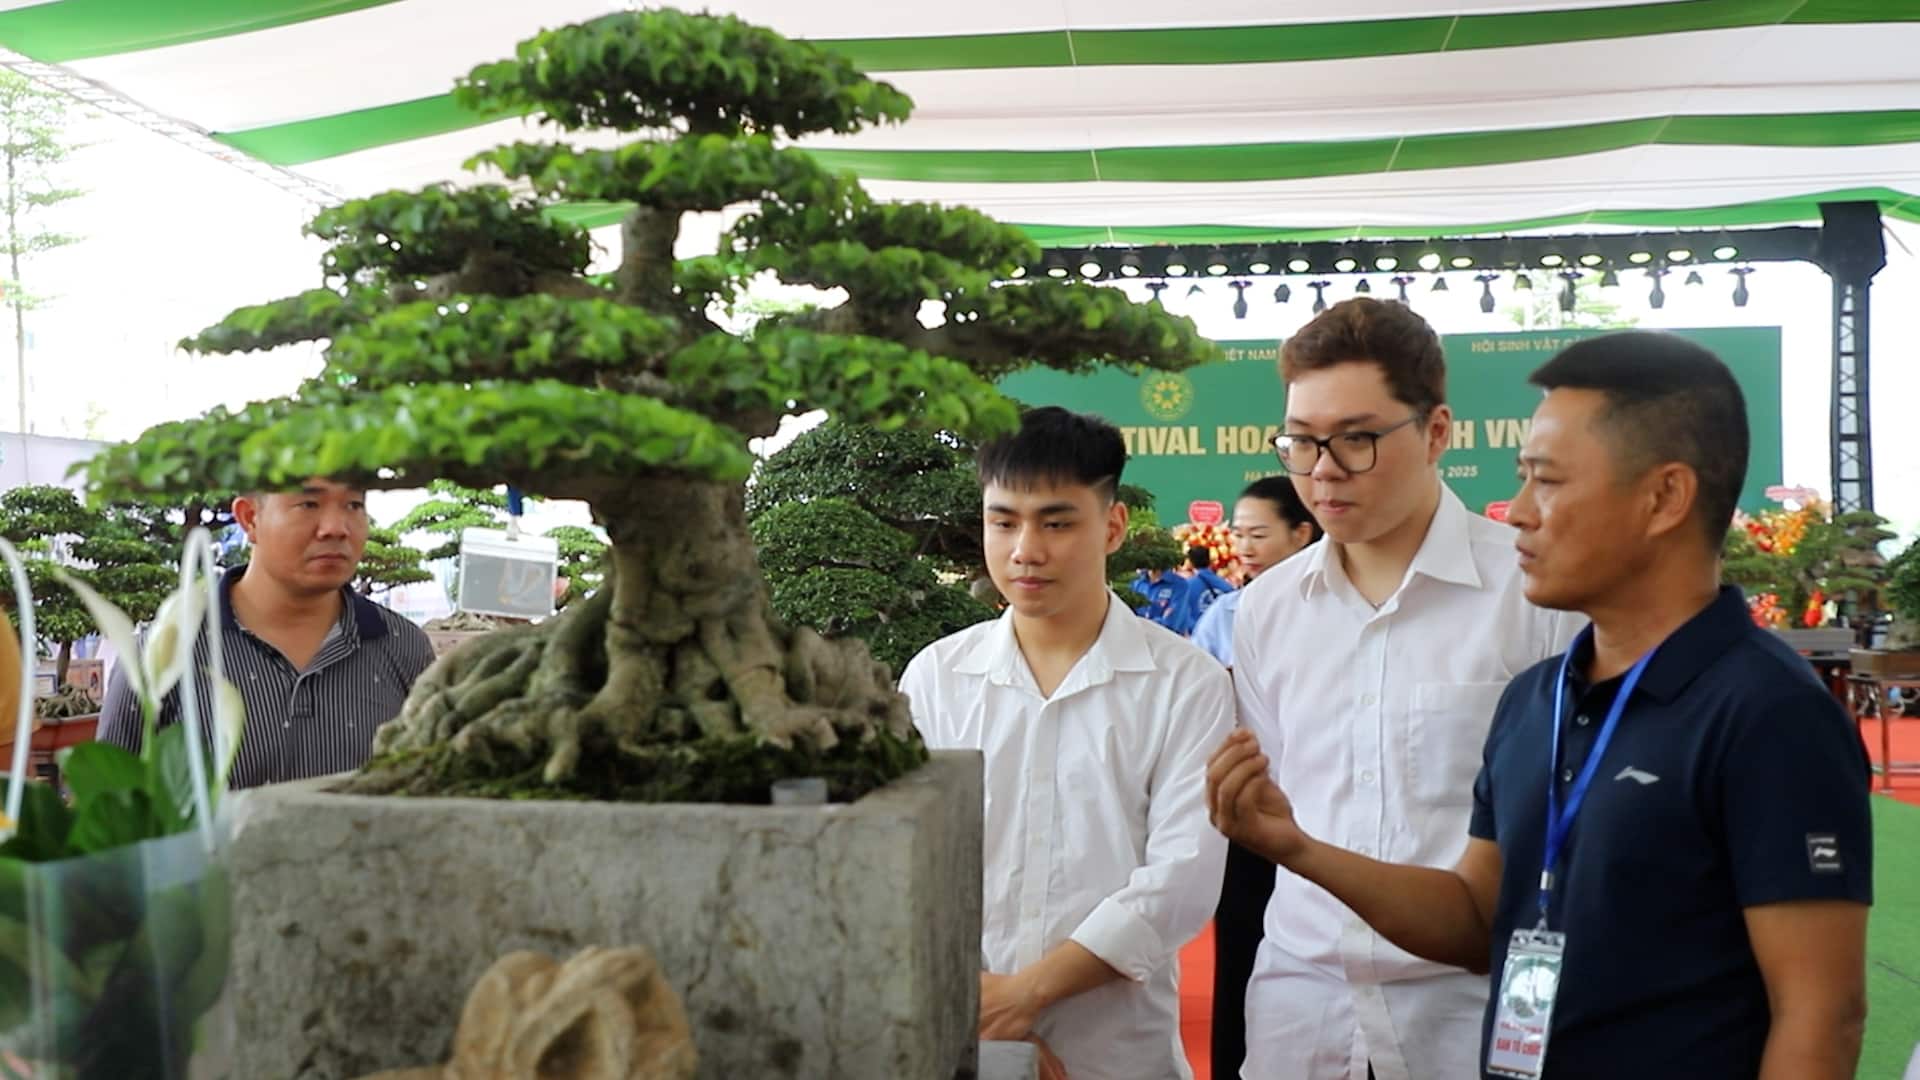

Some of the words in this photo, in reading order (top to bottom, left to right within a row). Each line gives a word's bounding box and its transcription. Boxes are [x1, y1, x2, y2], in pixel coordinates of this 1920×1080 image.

[1497, 339, 1530, 353] SINH
[1247, 349, 1277, 361] NAM
[1120, 427, 1207, 456] TIVAL
[1216, 426, 1280, 455] HOA
[1447, 465, 1478, 478] 2025
